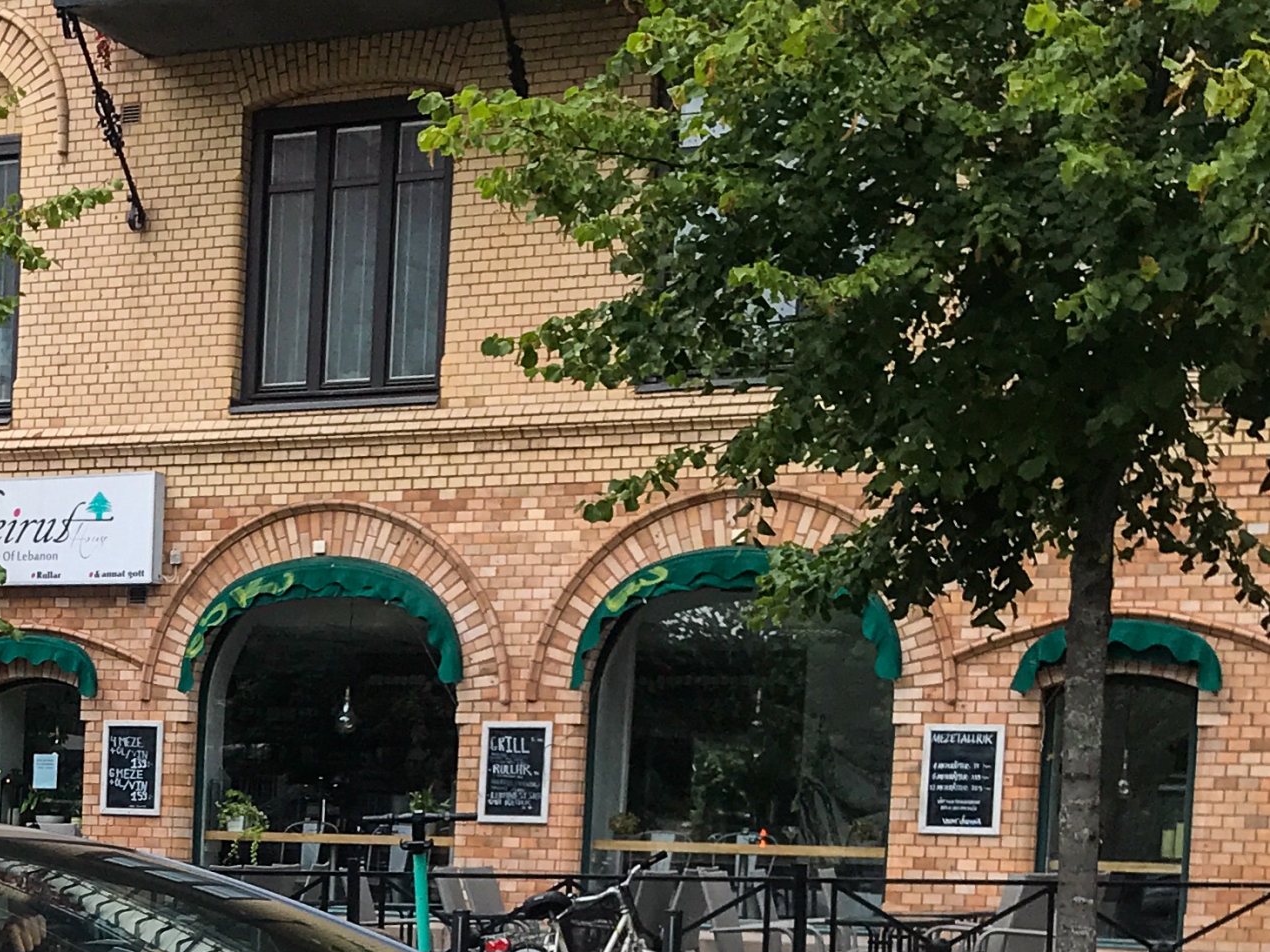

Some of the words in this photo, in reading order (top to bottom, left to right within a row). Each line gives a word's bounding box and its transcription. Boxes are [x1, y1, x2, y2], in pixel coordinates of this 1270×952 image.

[2, 550, 15, 562] Of
[17, 550, 59, 562] Lebanon
[490, 735, 531, 754] GRILL
